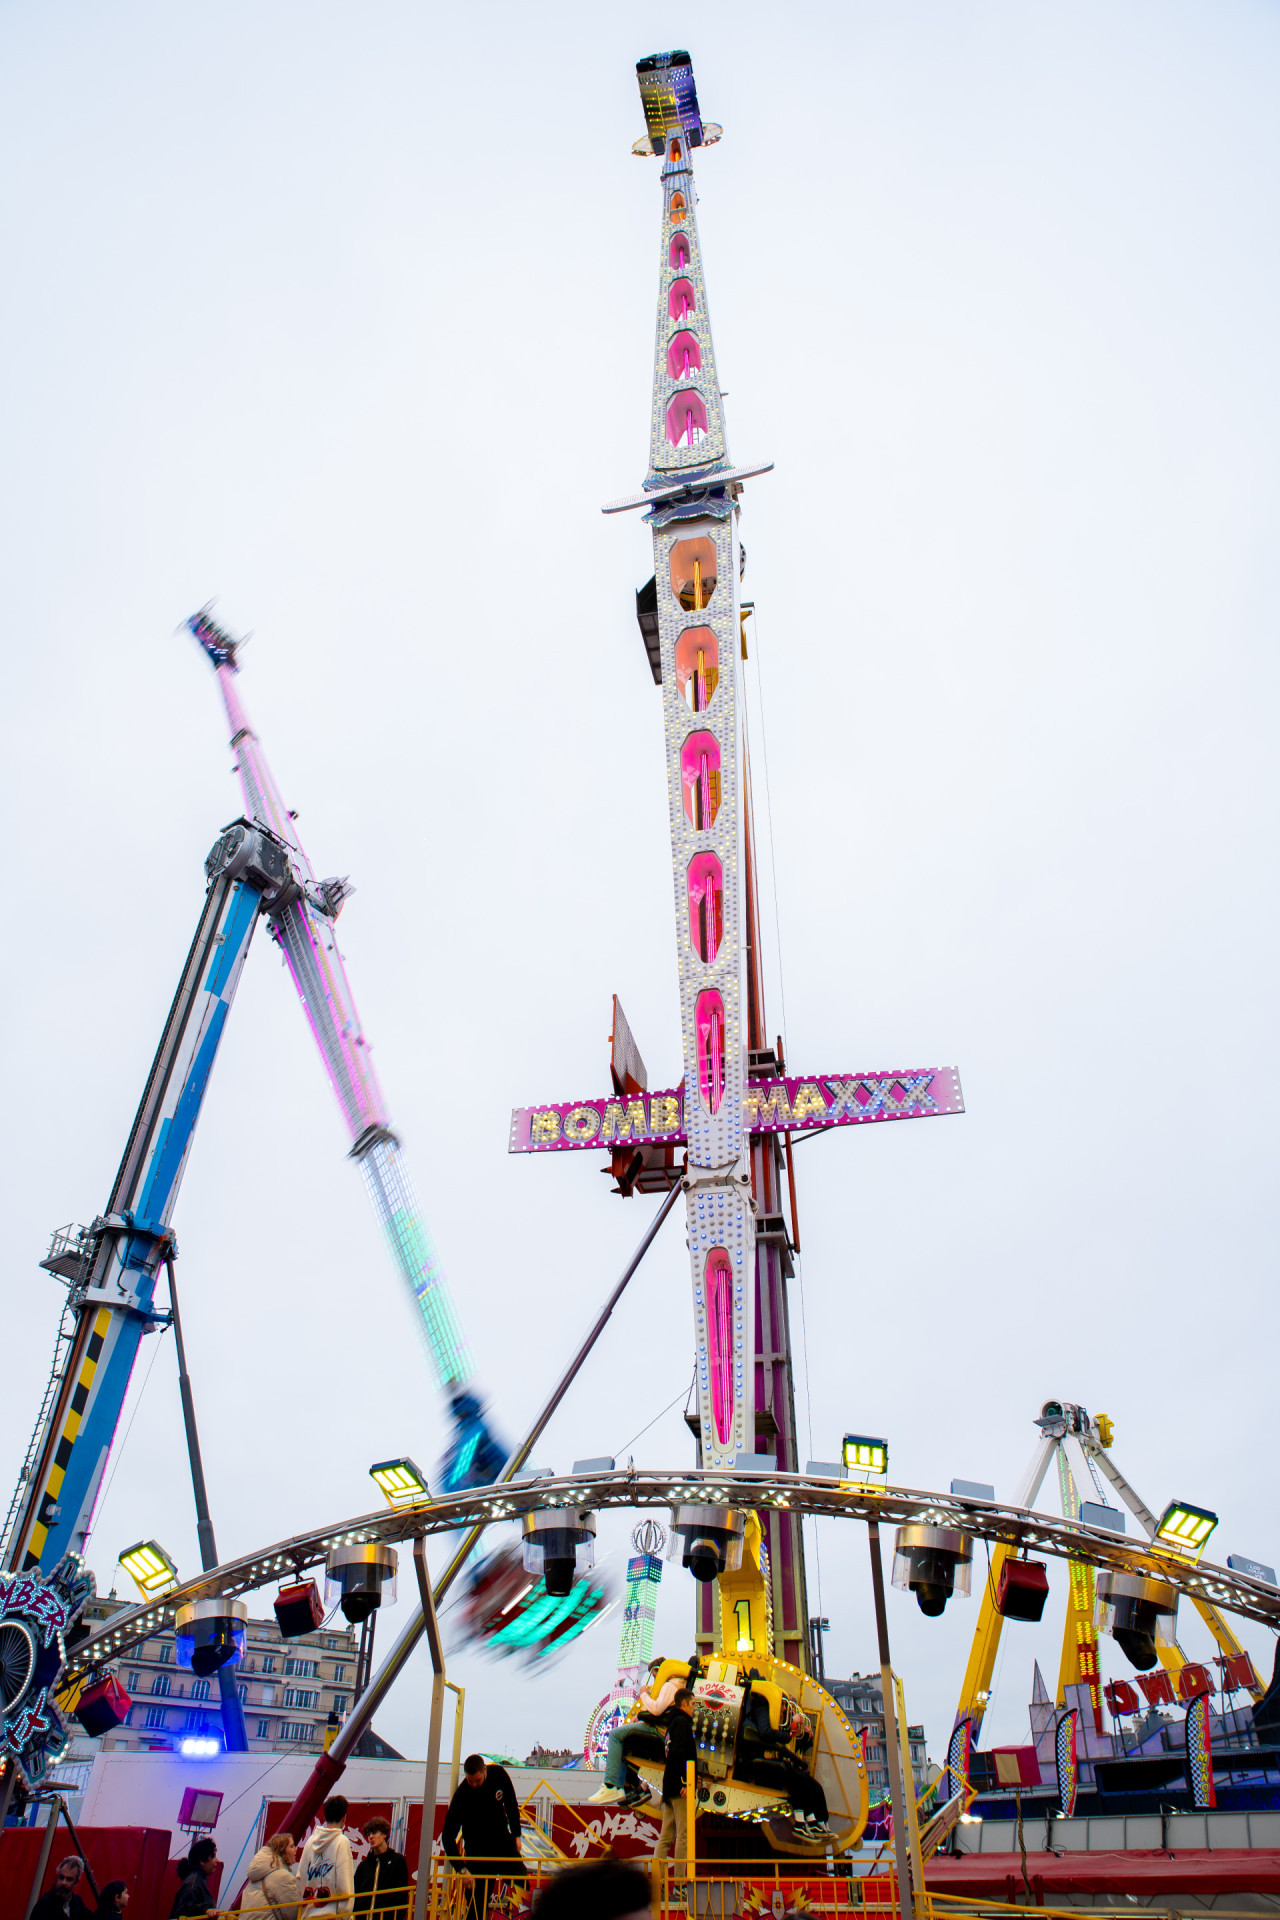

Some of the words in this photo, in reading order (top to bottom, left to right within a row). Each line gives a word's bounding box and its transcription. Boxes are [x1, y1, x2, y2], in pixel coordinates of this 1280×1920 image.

[744, 1076, 938, 1126] MAXXX
[0, 1573, 71, 1649] MBER
[733, 1599, 755, 1652] 1
[698, 1683, 736, 1700] BOMBER
[719, 1663, 728, 1682] 1
[957, 1727, 967, 1770] ROYAL
[1063, 1718, 1073, 1762] ROYAL
[1195, 1702, 1205, 1750] ROYAL
[1196, 1752, 1209, 1803] MINOS
[569, 1810, 662, 1859] BOMBE
